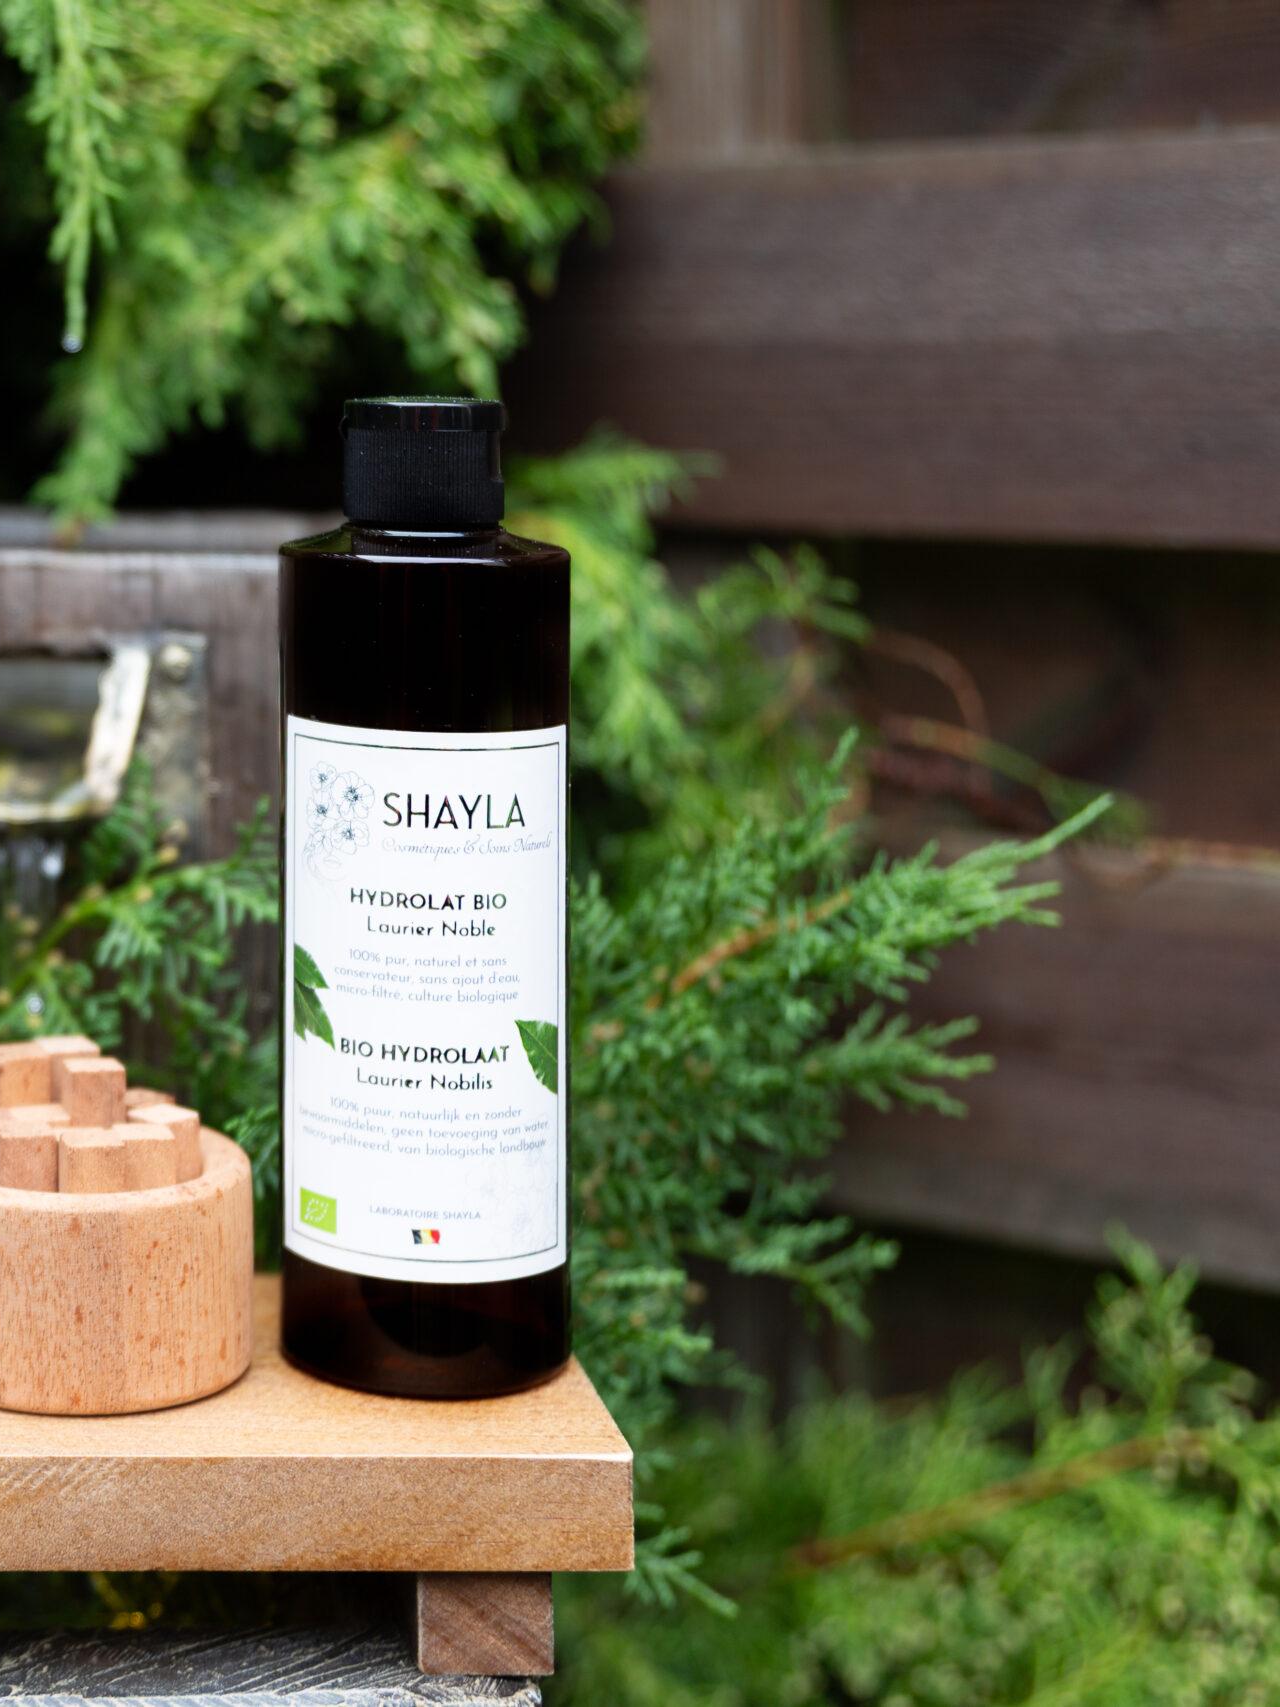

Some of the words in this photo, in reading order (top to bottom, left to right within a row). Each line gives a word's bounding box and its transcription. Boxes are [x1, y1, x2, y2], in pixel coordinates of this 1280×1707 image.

[383, 792, 525, 829] SHAYLA
[350, 887, 465, 910] HYDROLAT
[474, 894, 507, 910] BIO
[367, 916, 434, 936] Laurier
[442, 919, 496, 936] Noble
[349, 949, 380, 963] 100%
[414, 955, 461, 967] naturel
[465, 957, 477, 967] et
[482, 957, 507, 967] sans
[419, 974, 448, 985] sans
[452, 974, 484, 987] ajout
[408, 989, 453, 1003] culture
[457, 990, 519, 1005] biologique
[340, 1037, 373, 1058] BIO
[381, 1044, 510, 1064] HYDROLAAT
[357, 1067, 422, 1089] Laurier
[431, 1073, 493, 1091] Nobilis
[330, 1096, 359, 1113] 100%
[400, 1108, 459, 1123] natuurlijk
[465, 1112, 480, 1121] en
[485, 1106, 522, 1121] zonder
[391, 1127, 423, 1138] geen
[429, 1128, 498, 1141] toevoeging
[502, 1126, 521, 1136] van
[398, 1145, 421, 1155] van
[426, 1143, 495, 1158] biologische
[500, 1138, 547, 1154] landbouw
[370, 1205, 439, 1219] LABORATOIRE
[443, 1211, 481, 1220] SHAYLA
